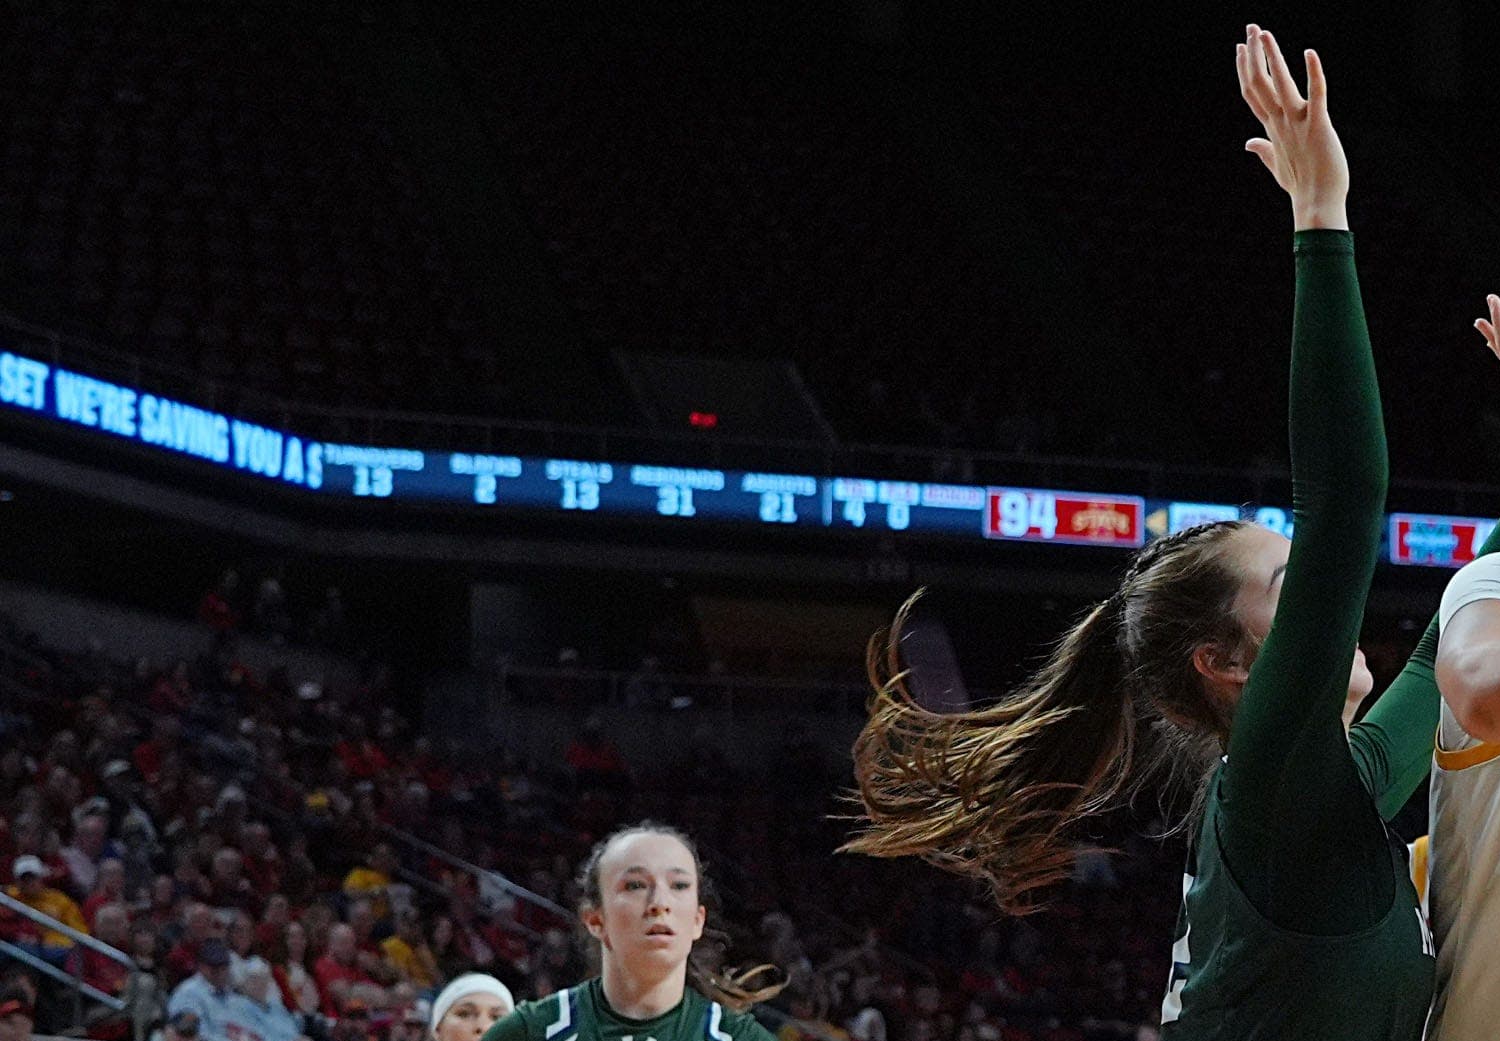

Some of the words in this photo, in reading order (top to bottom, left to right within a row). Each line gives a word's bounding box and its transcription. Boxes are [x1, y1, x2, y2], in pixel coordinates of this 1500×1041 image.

[0, 351, 49, 411] SET
[139, 393, 230, 463] SAVING
[231, 419, 283, 478] YOU
[282, 436, 305, 484] A
[656, 485, 697, 517] 31
[758, 492, 798, 524] 21
[997, 490, 1058, 539] 94
